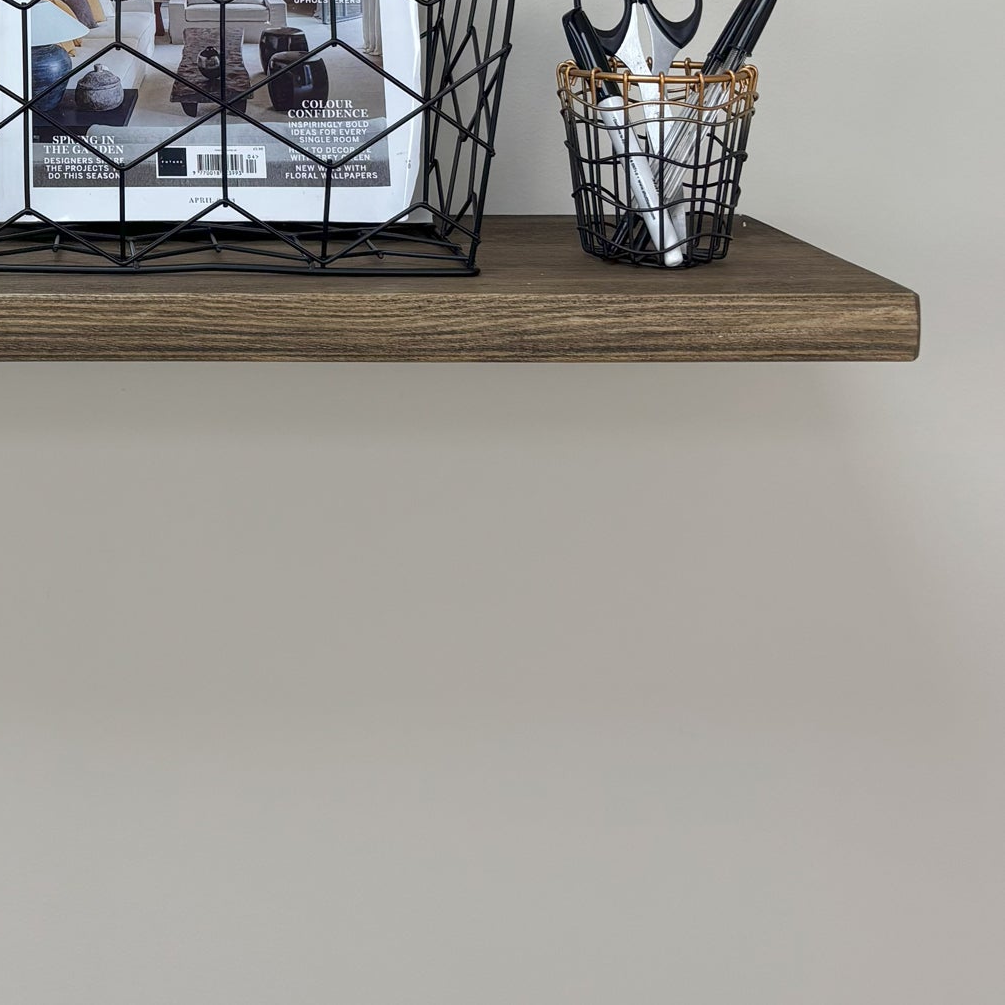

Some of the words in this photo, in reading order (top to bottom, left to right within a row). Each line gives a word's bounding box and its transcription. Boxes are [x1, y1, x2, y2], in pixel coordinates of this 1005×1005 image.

[302, 100, 353, 109] COLOUR
[288, 109, 368, 118] CONFIDENCE
[102, 136, 115, 144] IN
[44, 145, 69, 154] THE
